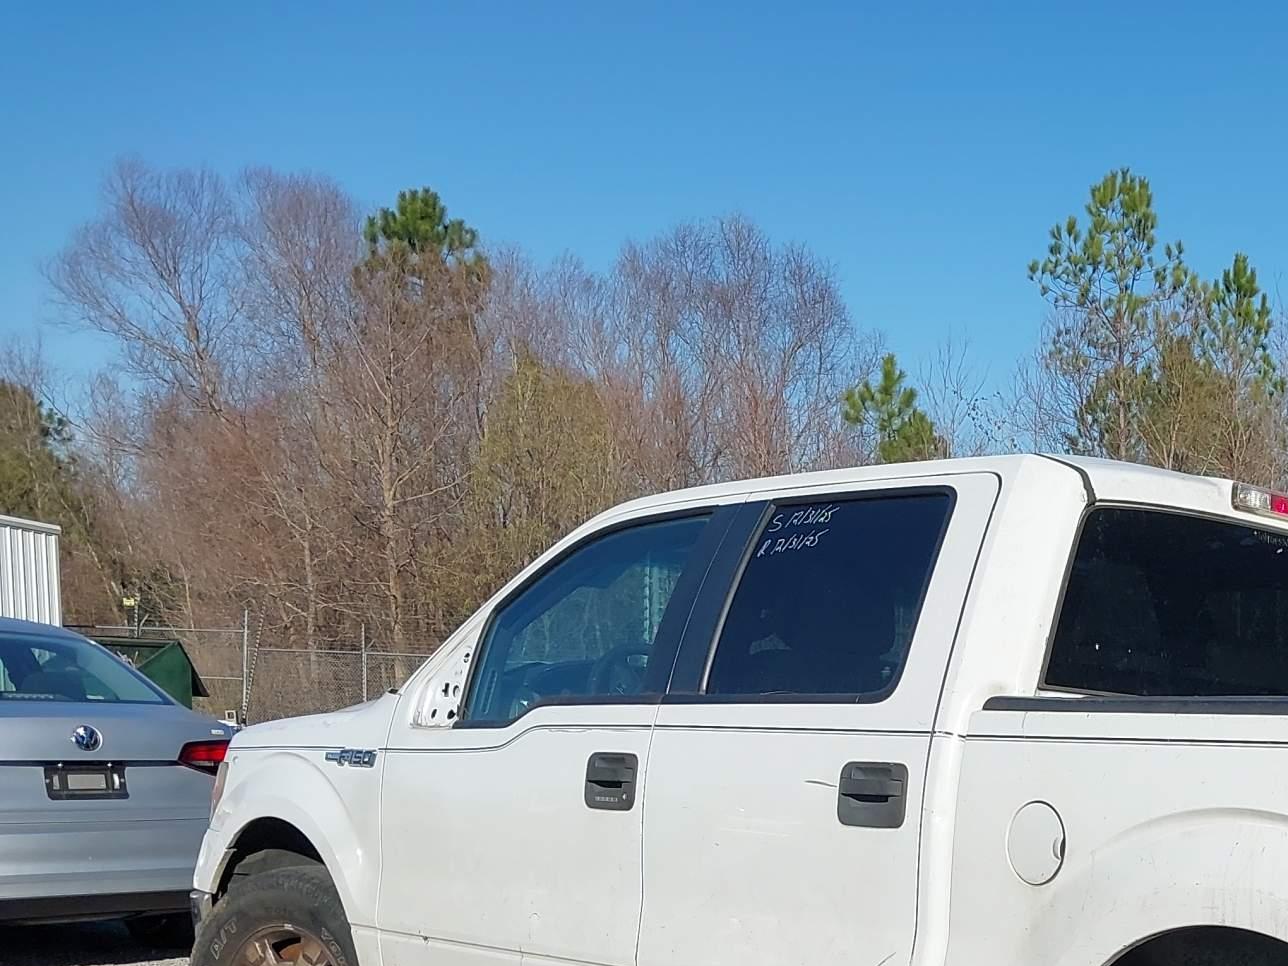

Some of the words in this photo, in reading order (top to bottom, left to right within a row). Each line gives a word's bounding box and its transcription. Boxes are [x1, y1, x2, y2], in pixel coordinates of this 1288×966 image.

[768, 514, 784, 532] S
[757, 539, 772, 558] R
[210, 917, 240, 960] A/T
